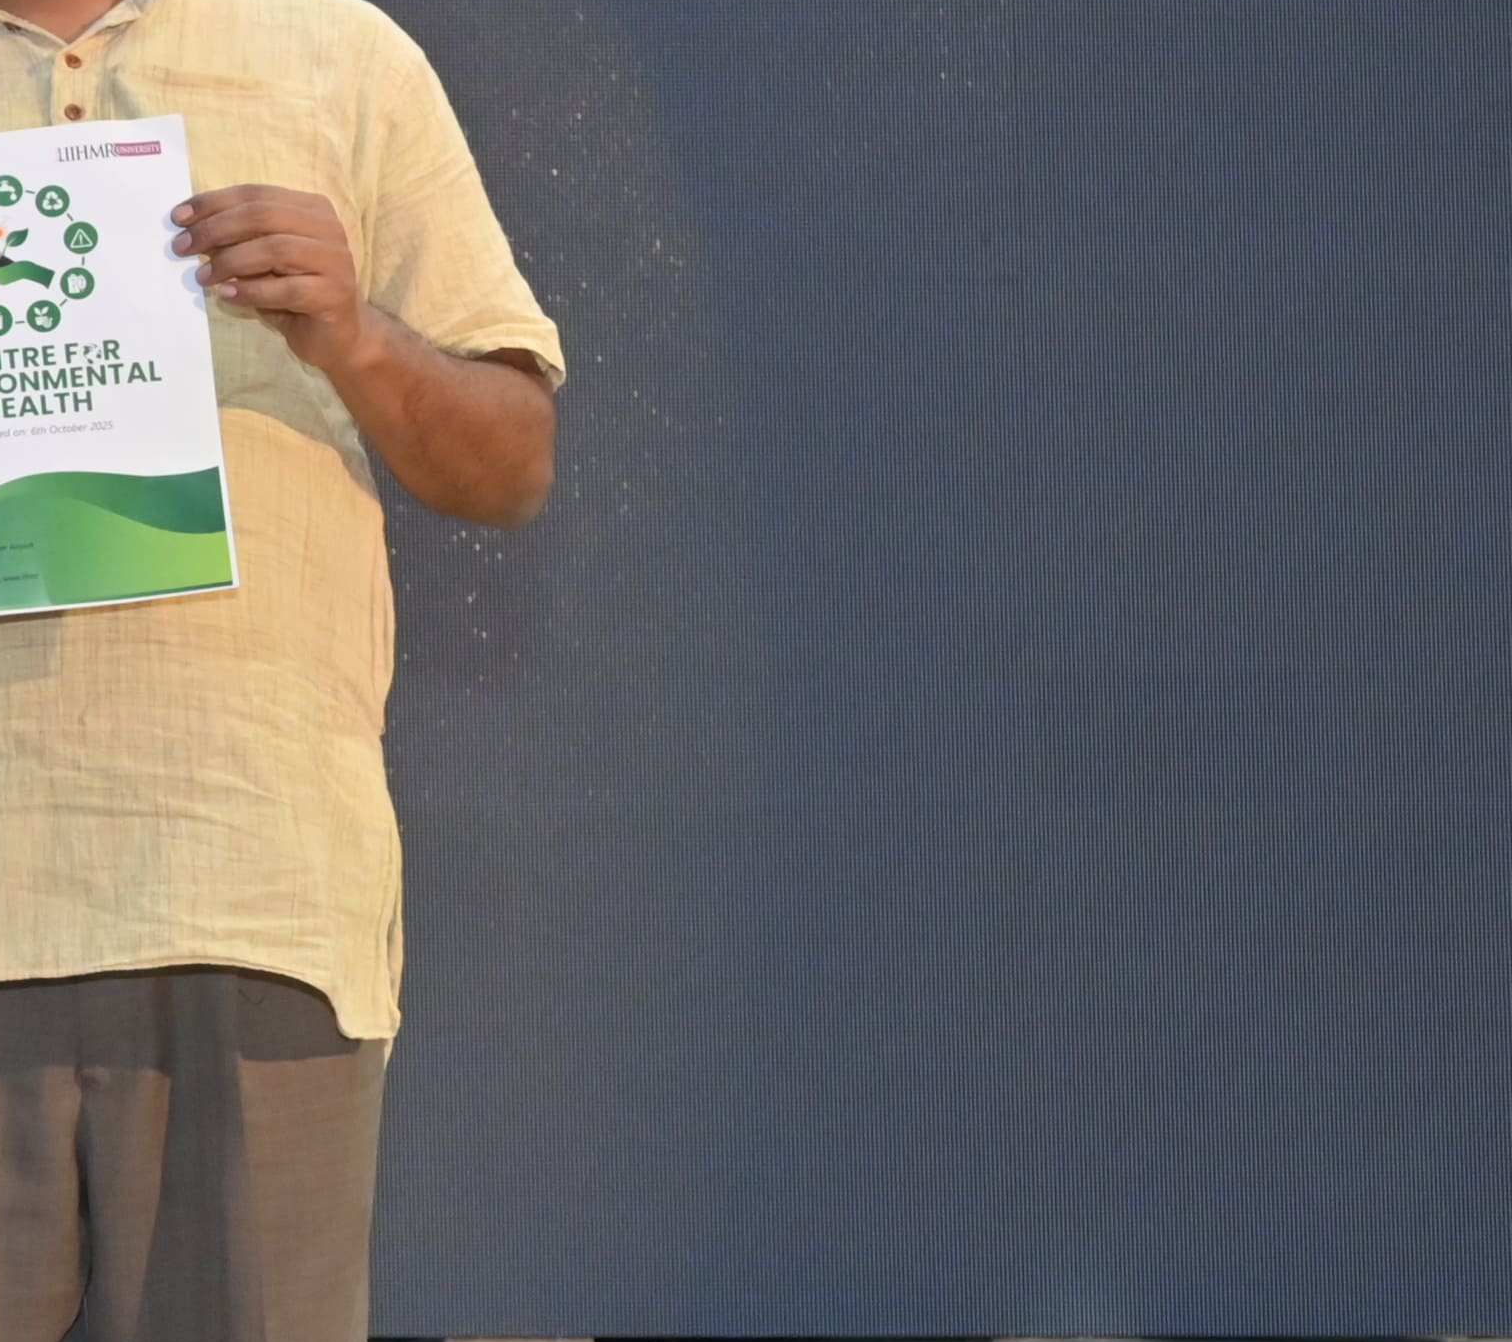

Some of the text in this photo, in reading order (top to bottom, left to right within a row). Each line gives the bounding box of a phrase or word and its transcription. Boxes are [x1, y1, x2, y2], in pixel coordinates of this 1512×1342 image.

[116, 143, 160, 155] UNIVERSITY
[30, 426, 47, 436] 6th
[49, 423, 88, 435] October
[89, 420, 113, 431] 2025
